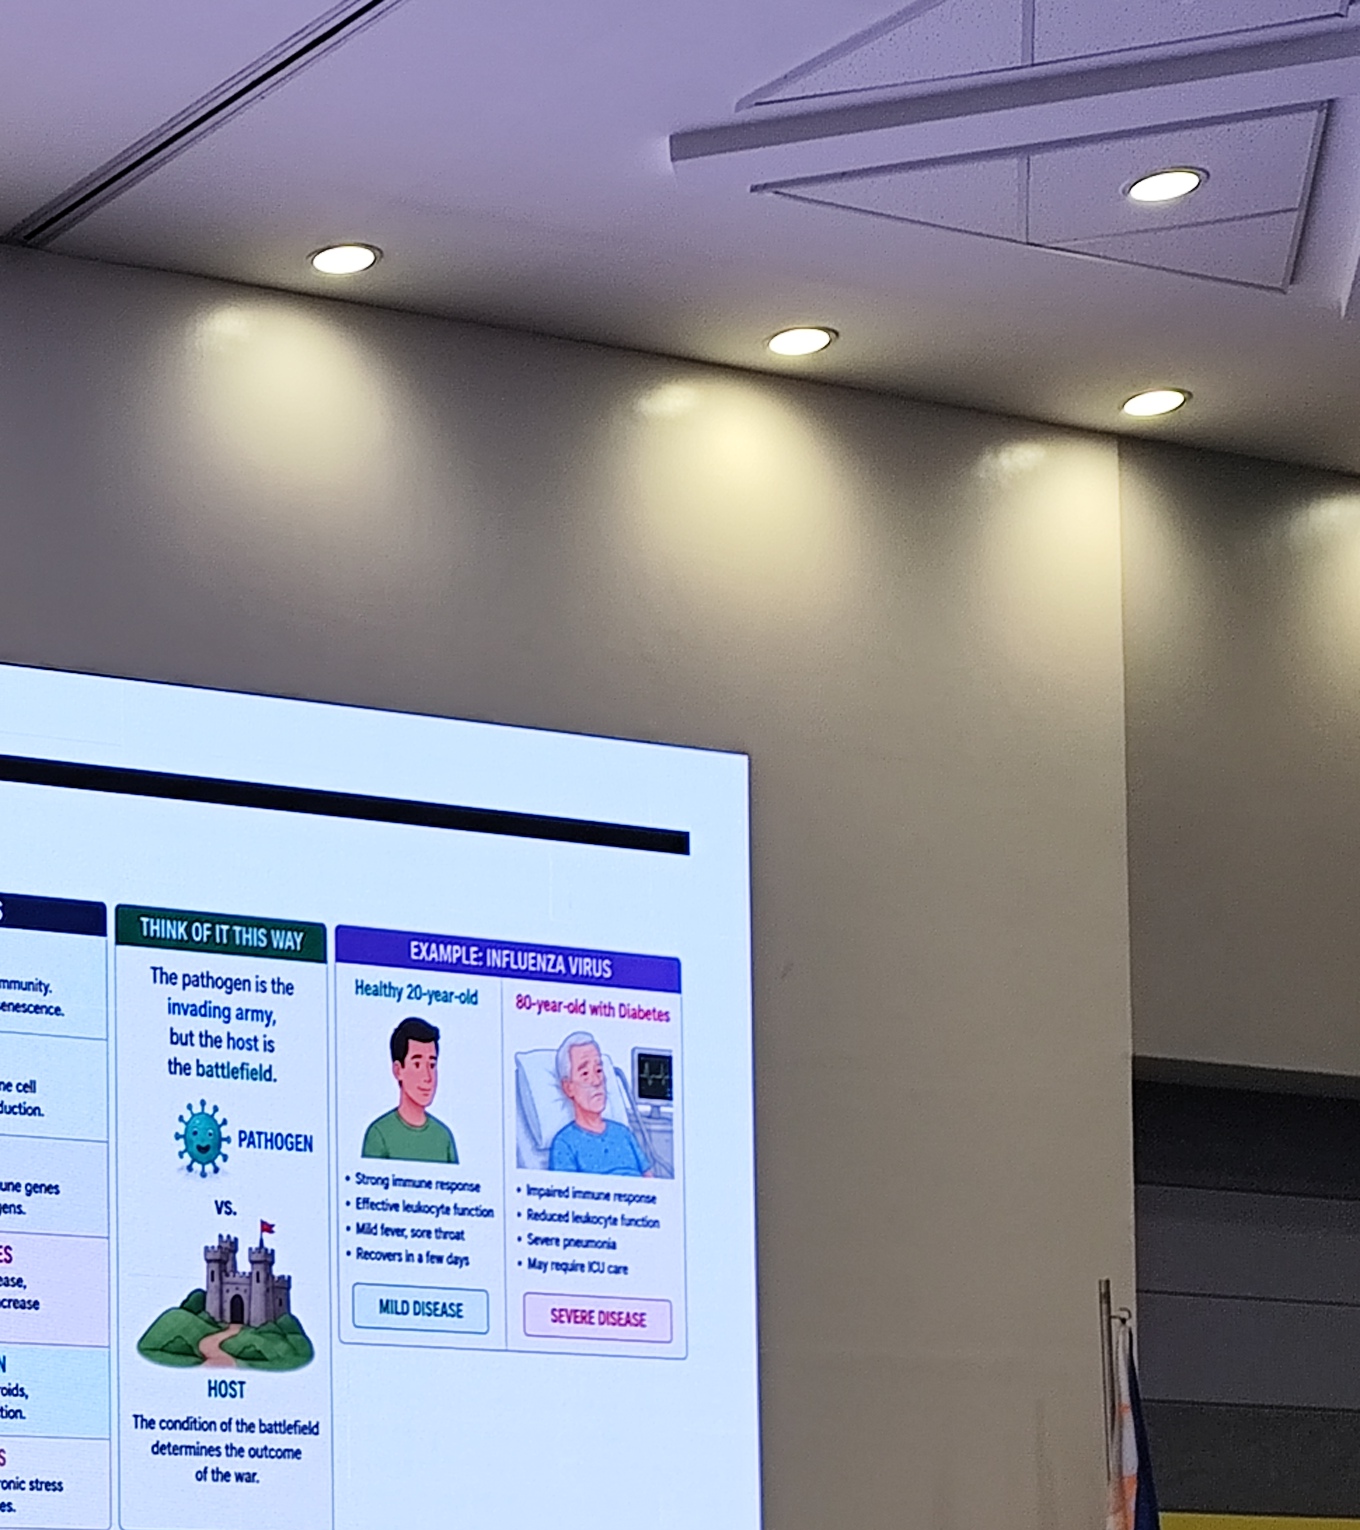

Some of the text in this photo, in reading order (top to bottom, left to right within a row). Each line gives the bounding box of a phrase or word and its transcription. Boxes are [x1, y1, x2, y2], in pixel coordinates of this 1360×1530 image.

[140, 917, 303, 950] THINK OF IT THIS WAY
[411, 941, 611, 978] EXAMPLE: INFLUENZA VIRUS
[150, 966, 294, 996] The pathogen is the
[355, 979, 478, 1005] Healthy 20-year-old
[167, 997, 276, 1028] invading army,
[516, 993, 670, 1022] 80-year-old with Diabetes
[170, 1026, 275, 1053] but the host is
[167, 1056, 277, 1082] the battlefield.
[15, 1079, 36, 1093] cell
[238, 1129, 312, 1152] PATHOGEN
[24, 1182, 60, 1196] genes
[355, 1171, 481, 1193] Strong immune response
[526, 1184, 656, 1205] Impaired immune response
[356, 1196, 494, 1218] Effective leukocyte function
[527, 1208, 659, 1228] Reduced leukocyte function
[356, 1222, 465, 1241] Mild fever, sore throat
[379, 1298, 463, 1318] MILD DISEASE
[551, 1308, 646, 1327] SEVERE DISEASE
[208, 1379, 246, 1398] HOST
[132, 1414, 319, 1435] The condition of the battlefield
[151, 1440, 302, 1460] determines the outcome
[29, 1478, 63, 1492] stress
